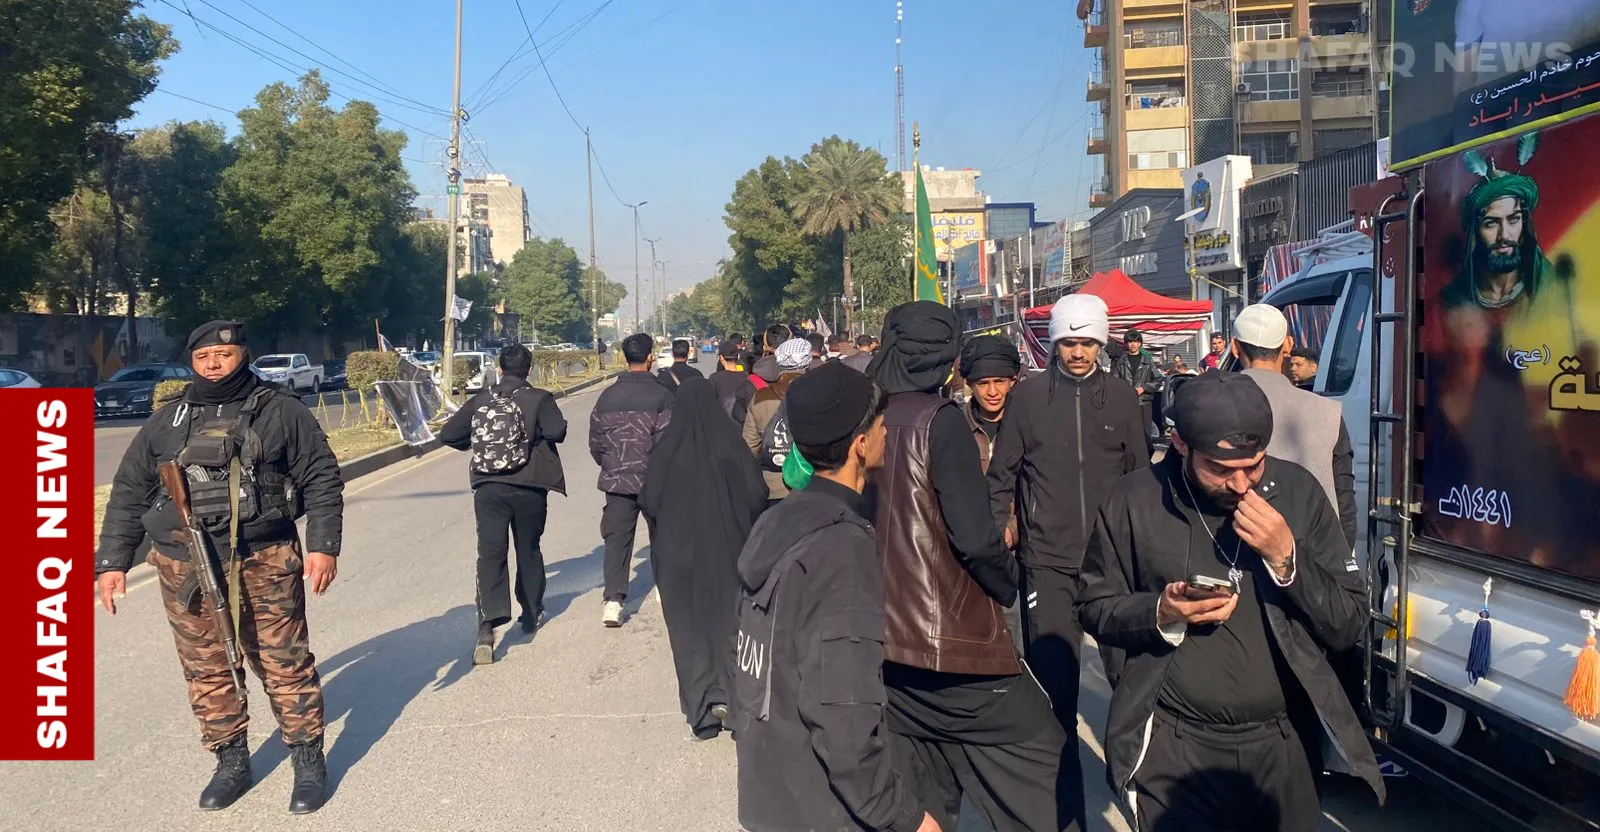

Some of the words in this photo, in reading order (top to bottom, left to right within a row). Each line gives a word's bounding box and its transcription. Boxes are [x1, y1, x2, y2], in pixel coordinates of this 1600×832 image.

[1540, 59, 1572, 82] خادم
[1575, 51, 1600, 69] حوم
[1470, 89, 1488, 105] (ع)
[1490, 70, 1537, 99] الحسين
[1523, 82, 1600, 117] يدر
[1120, 205, 1151, 242] VIP
[1505, 344, 1550, 370] (عج)
